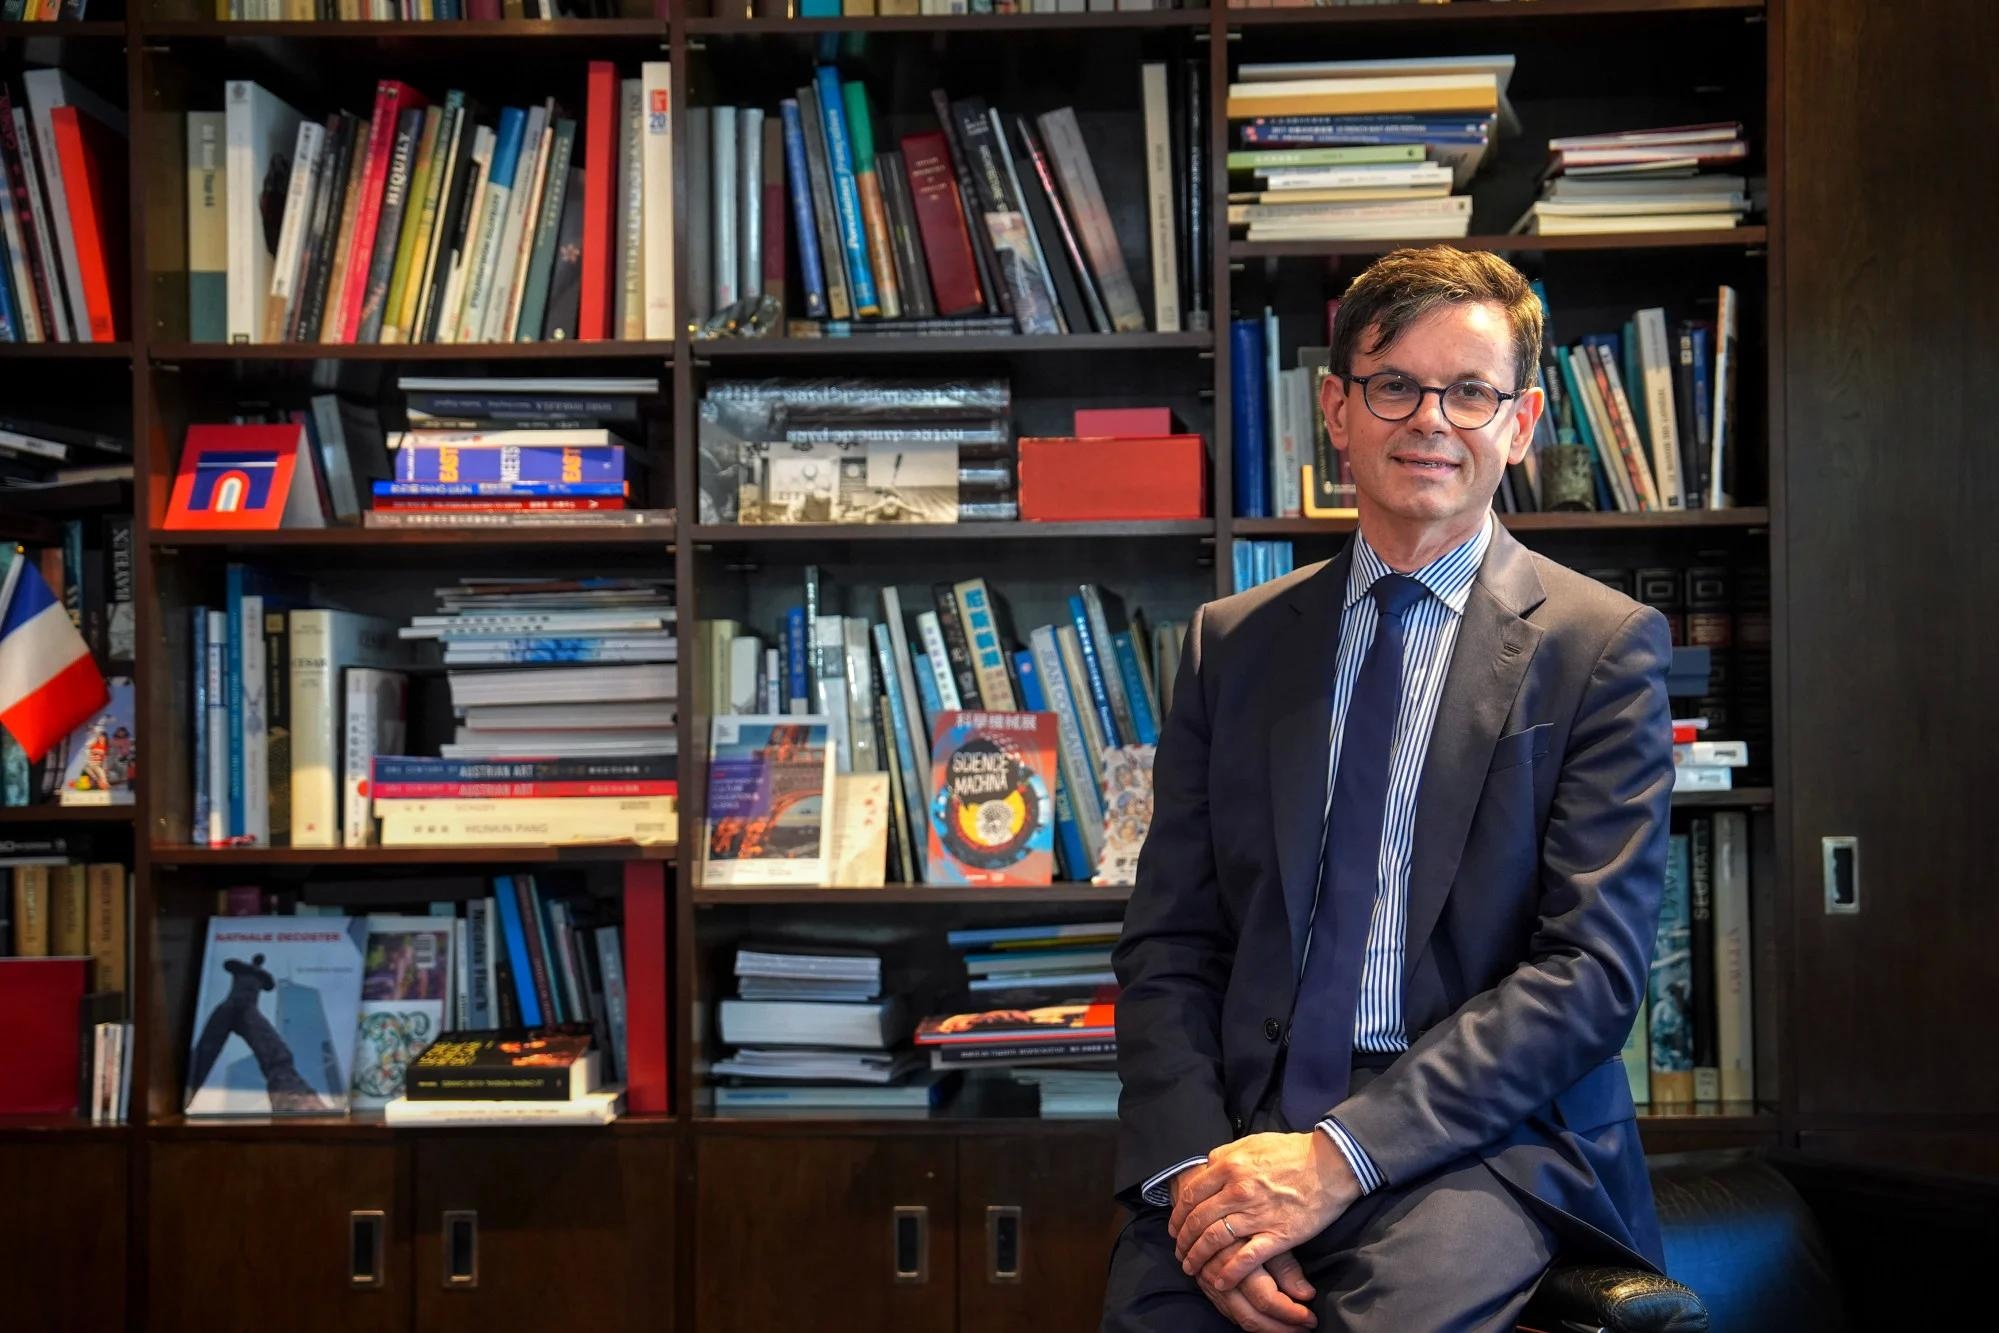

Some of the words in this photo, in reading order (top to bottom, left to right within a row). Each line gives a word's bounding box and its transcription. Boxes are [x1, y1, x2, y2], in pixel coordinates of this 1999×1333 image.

[953, 751, 1010, 774] SCIENCE
[459, 765, 511, 777] AUSTRIAN
[513, 764, 534, 776] ART
[513, 783, 534, 796] ART
[954, 771, 1009, 795] MACHINA
[215, 932, 272, 944] NATHALIE
[276, 932, 342, 942] DECOSTER
